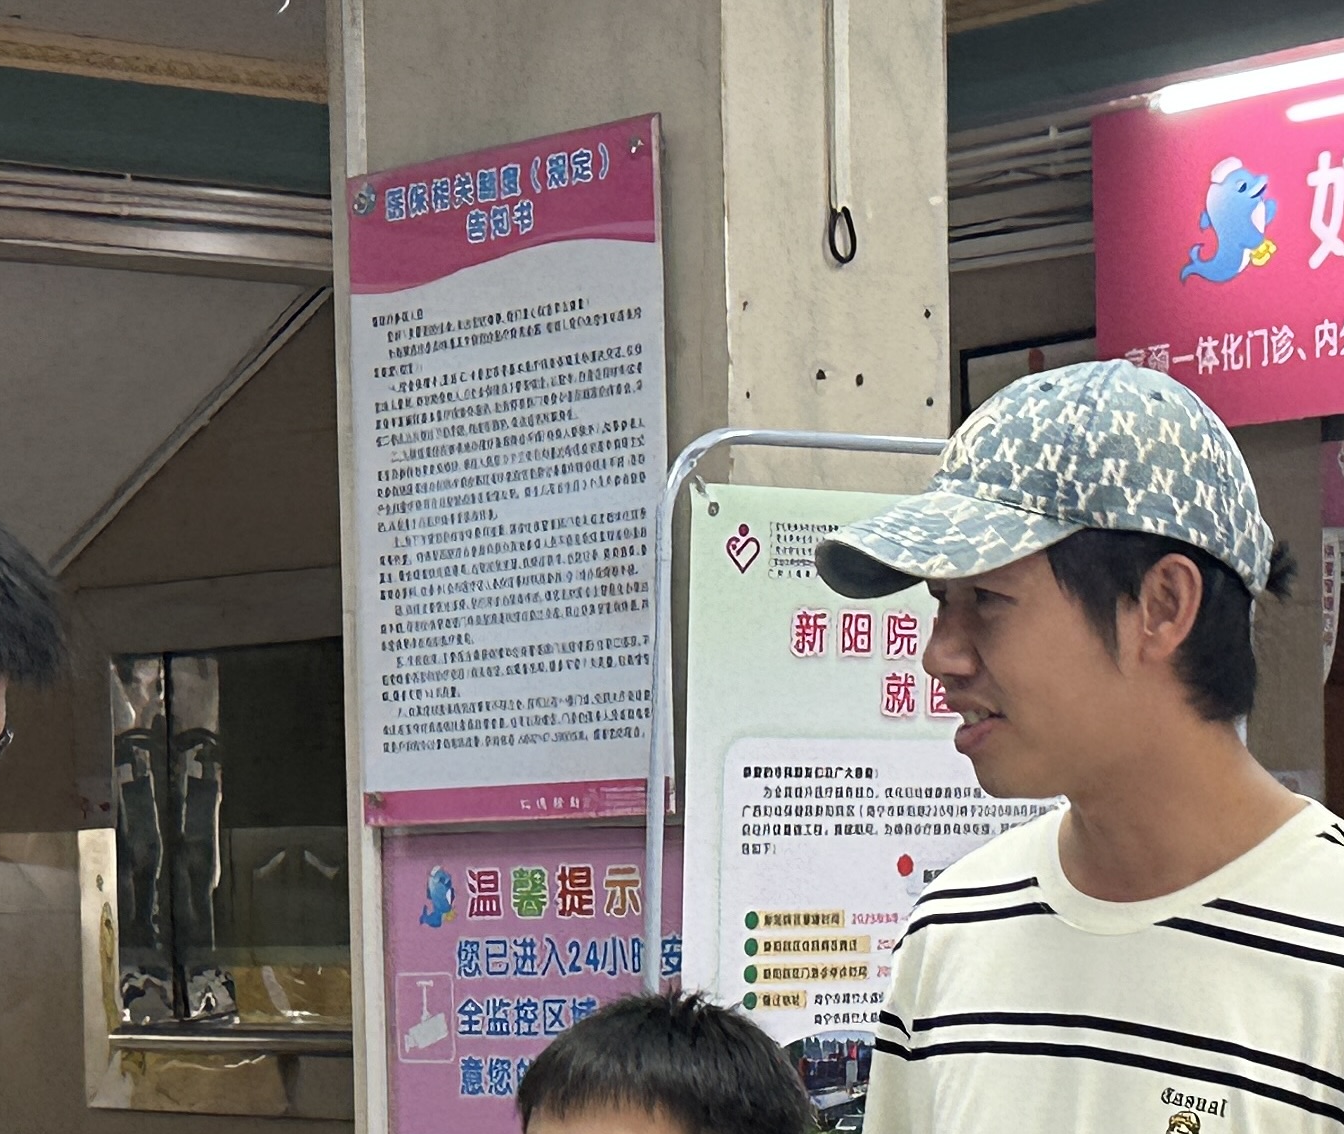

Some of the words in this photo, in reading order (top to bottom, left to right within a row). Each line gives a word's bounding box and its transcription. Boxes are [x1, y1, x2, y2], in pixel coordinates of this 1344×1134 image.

[791, 608, 937, 660] 新阳院
[466, 864, 643, 920] 温馨提示
[1161, 1087, 1228, 1117] Casual
